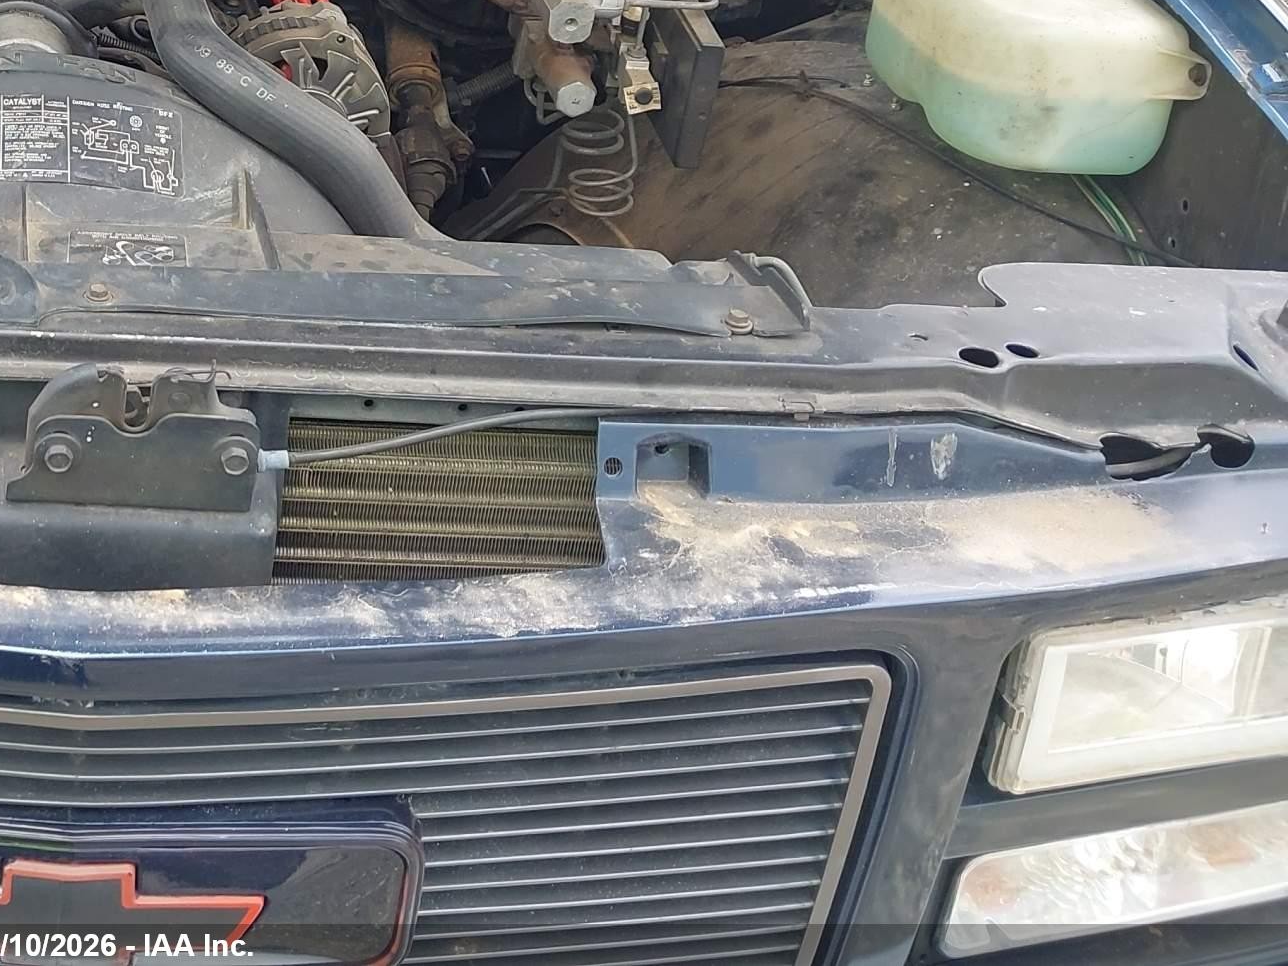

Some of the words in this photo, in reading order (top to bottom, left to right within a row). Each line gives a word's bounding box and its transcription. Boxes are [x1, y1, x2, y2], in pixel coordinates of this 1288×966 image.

[56, 55, 137, 85] FAN
[215, 57, 235, 75] 88
[239, 75, 253, 88] C
[255, 87, 277, 104] DF
[3, 97, 42, 106] CATALYST
